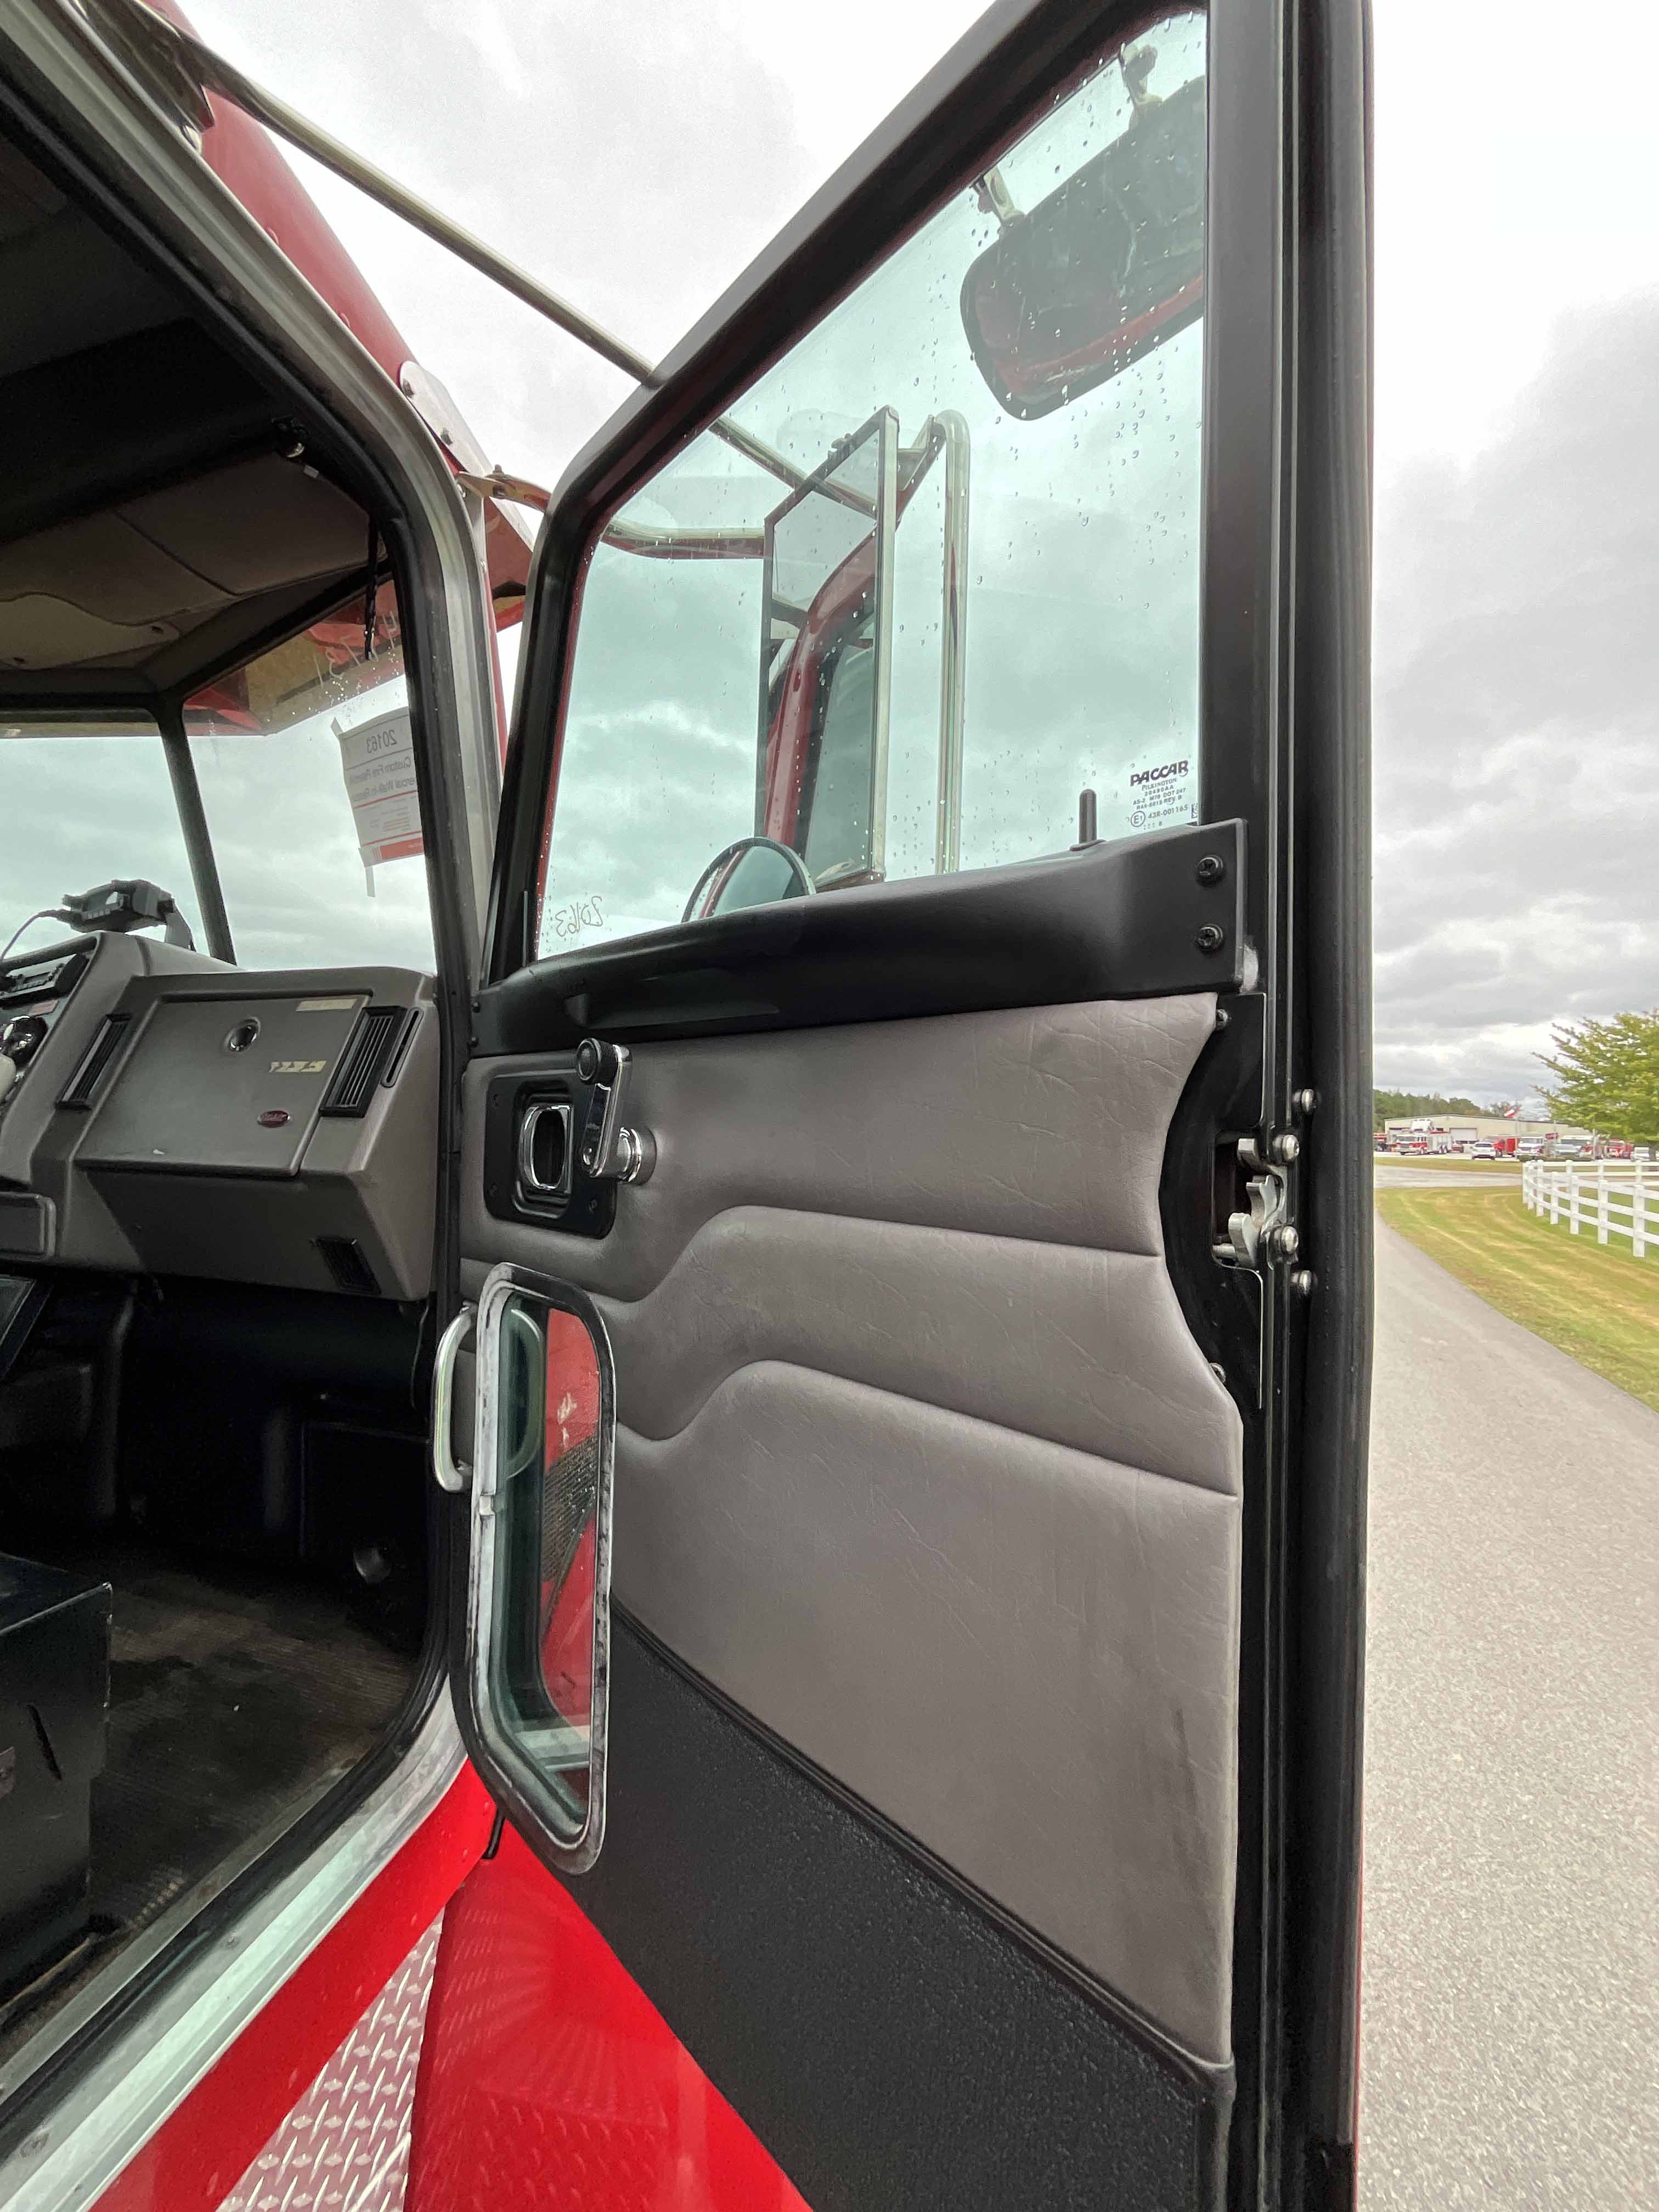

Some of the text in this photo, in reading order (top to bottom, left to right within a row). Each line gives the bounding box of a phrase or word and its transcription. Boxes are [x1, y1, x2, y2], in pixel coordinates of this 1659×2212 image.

[1130, 760, 1189, 787] PACCAR
[1141, 777, 1177, 791] PILKINGTON
[1148, 804, 1188, 819] 43R-001165
